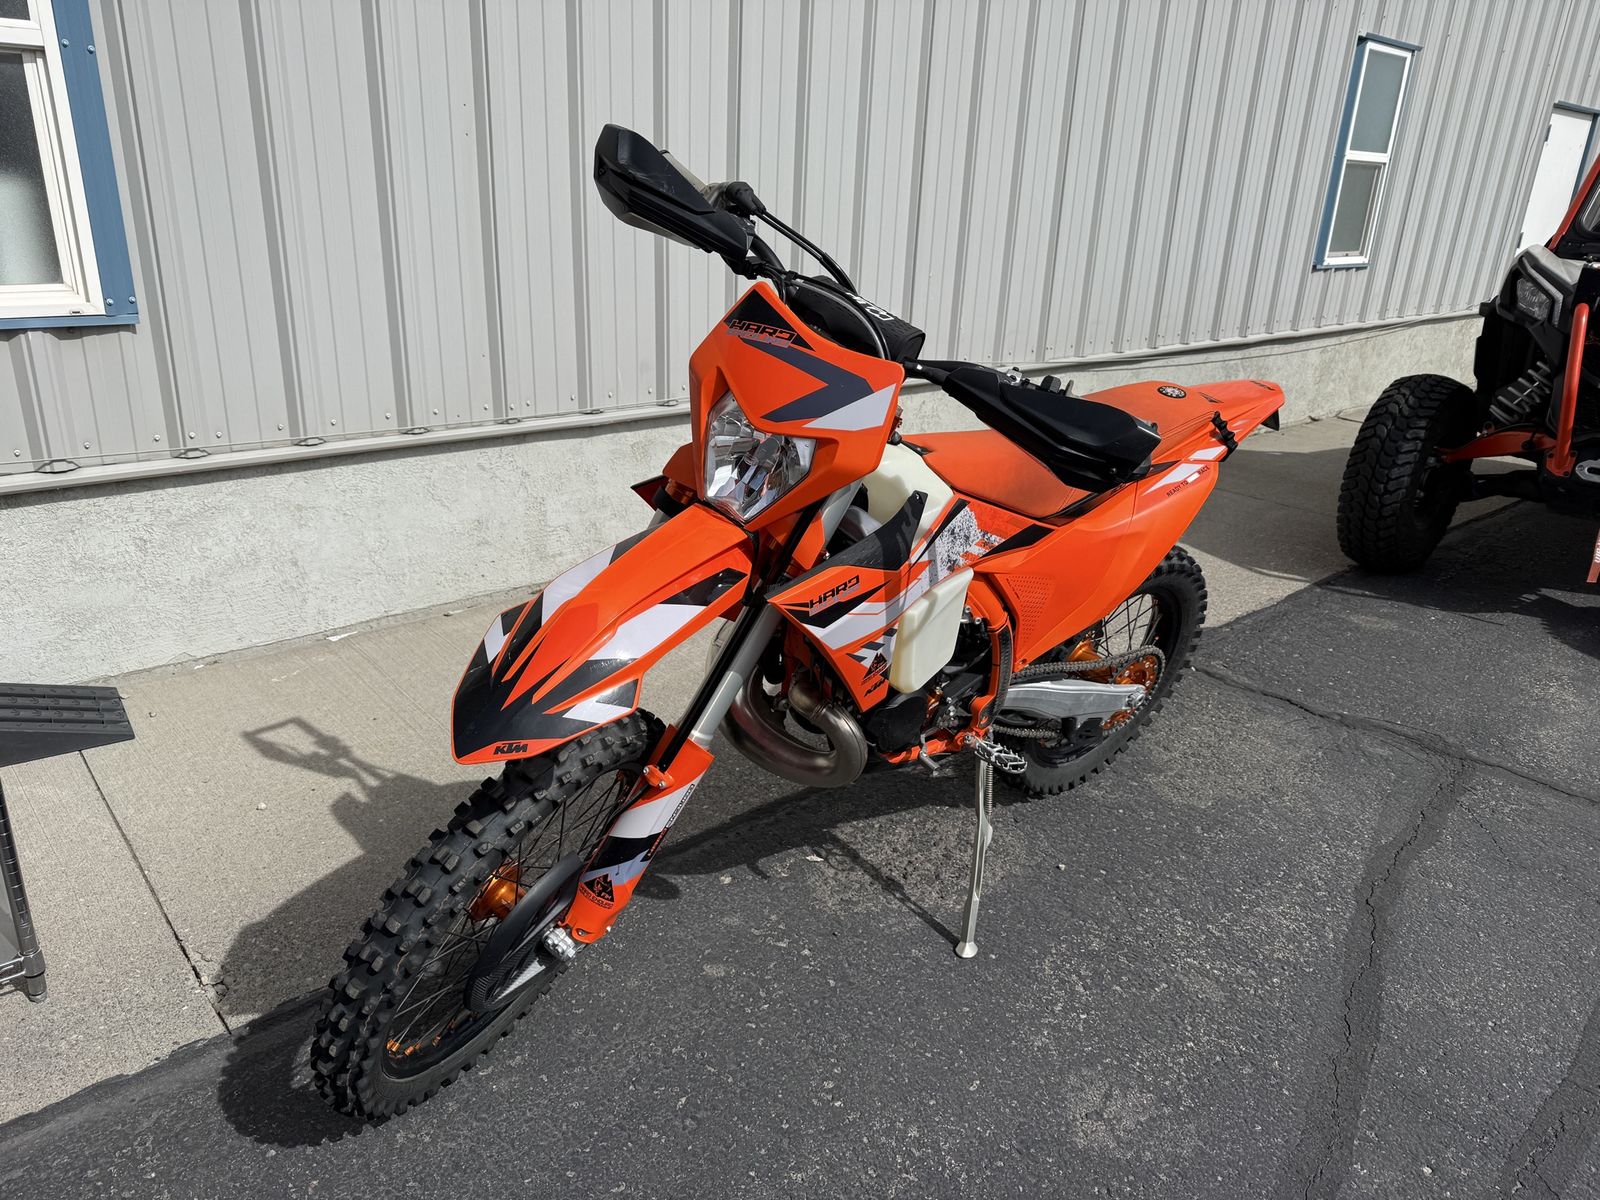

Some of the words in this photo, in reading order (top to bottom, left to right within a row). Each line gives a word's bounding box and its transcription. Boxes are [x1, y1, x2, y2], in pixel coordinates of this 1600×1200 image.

[729, 319, 797, 341] HARD
[1166, 484, 1182, 497] READY
[809, 575, 859, 609] HARD
[493, 742, 529, 755] KTM
